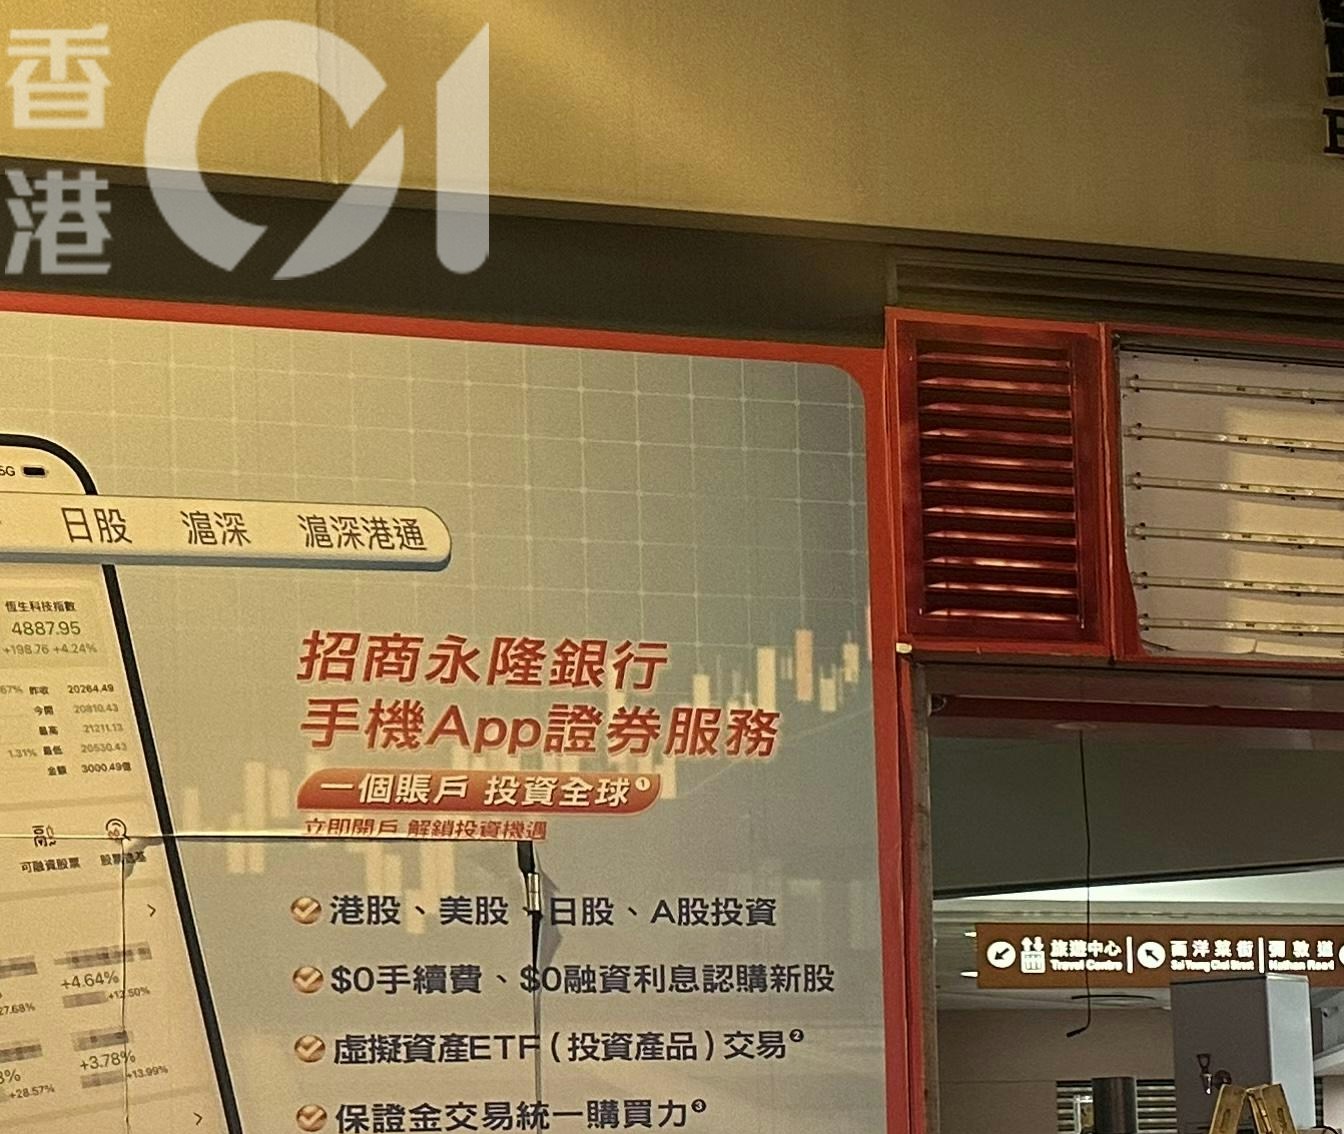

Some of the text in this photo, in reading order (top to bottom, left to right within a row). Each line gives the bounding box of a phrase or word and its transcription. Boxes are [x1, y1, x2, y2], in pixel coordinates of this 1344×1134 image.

[61, 507, 133, 544] 日股
[11, 620, 82, 636] 4887.95
[296, 629, 669, 692] 招商永隆銀行
[299, 697, 781, 759] 手機App證券服務
[483, 775, 632, 808] 投資全球
[61, 970, 119, 990] +4.64%
[80, 1050, 136, 1071] +3.78%
[335, 1099, 688, 1134] 保證金交易統一購買力
